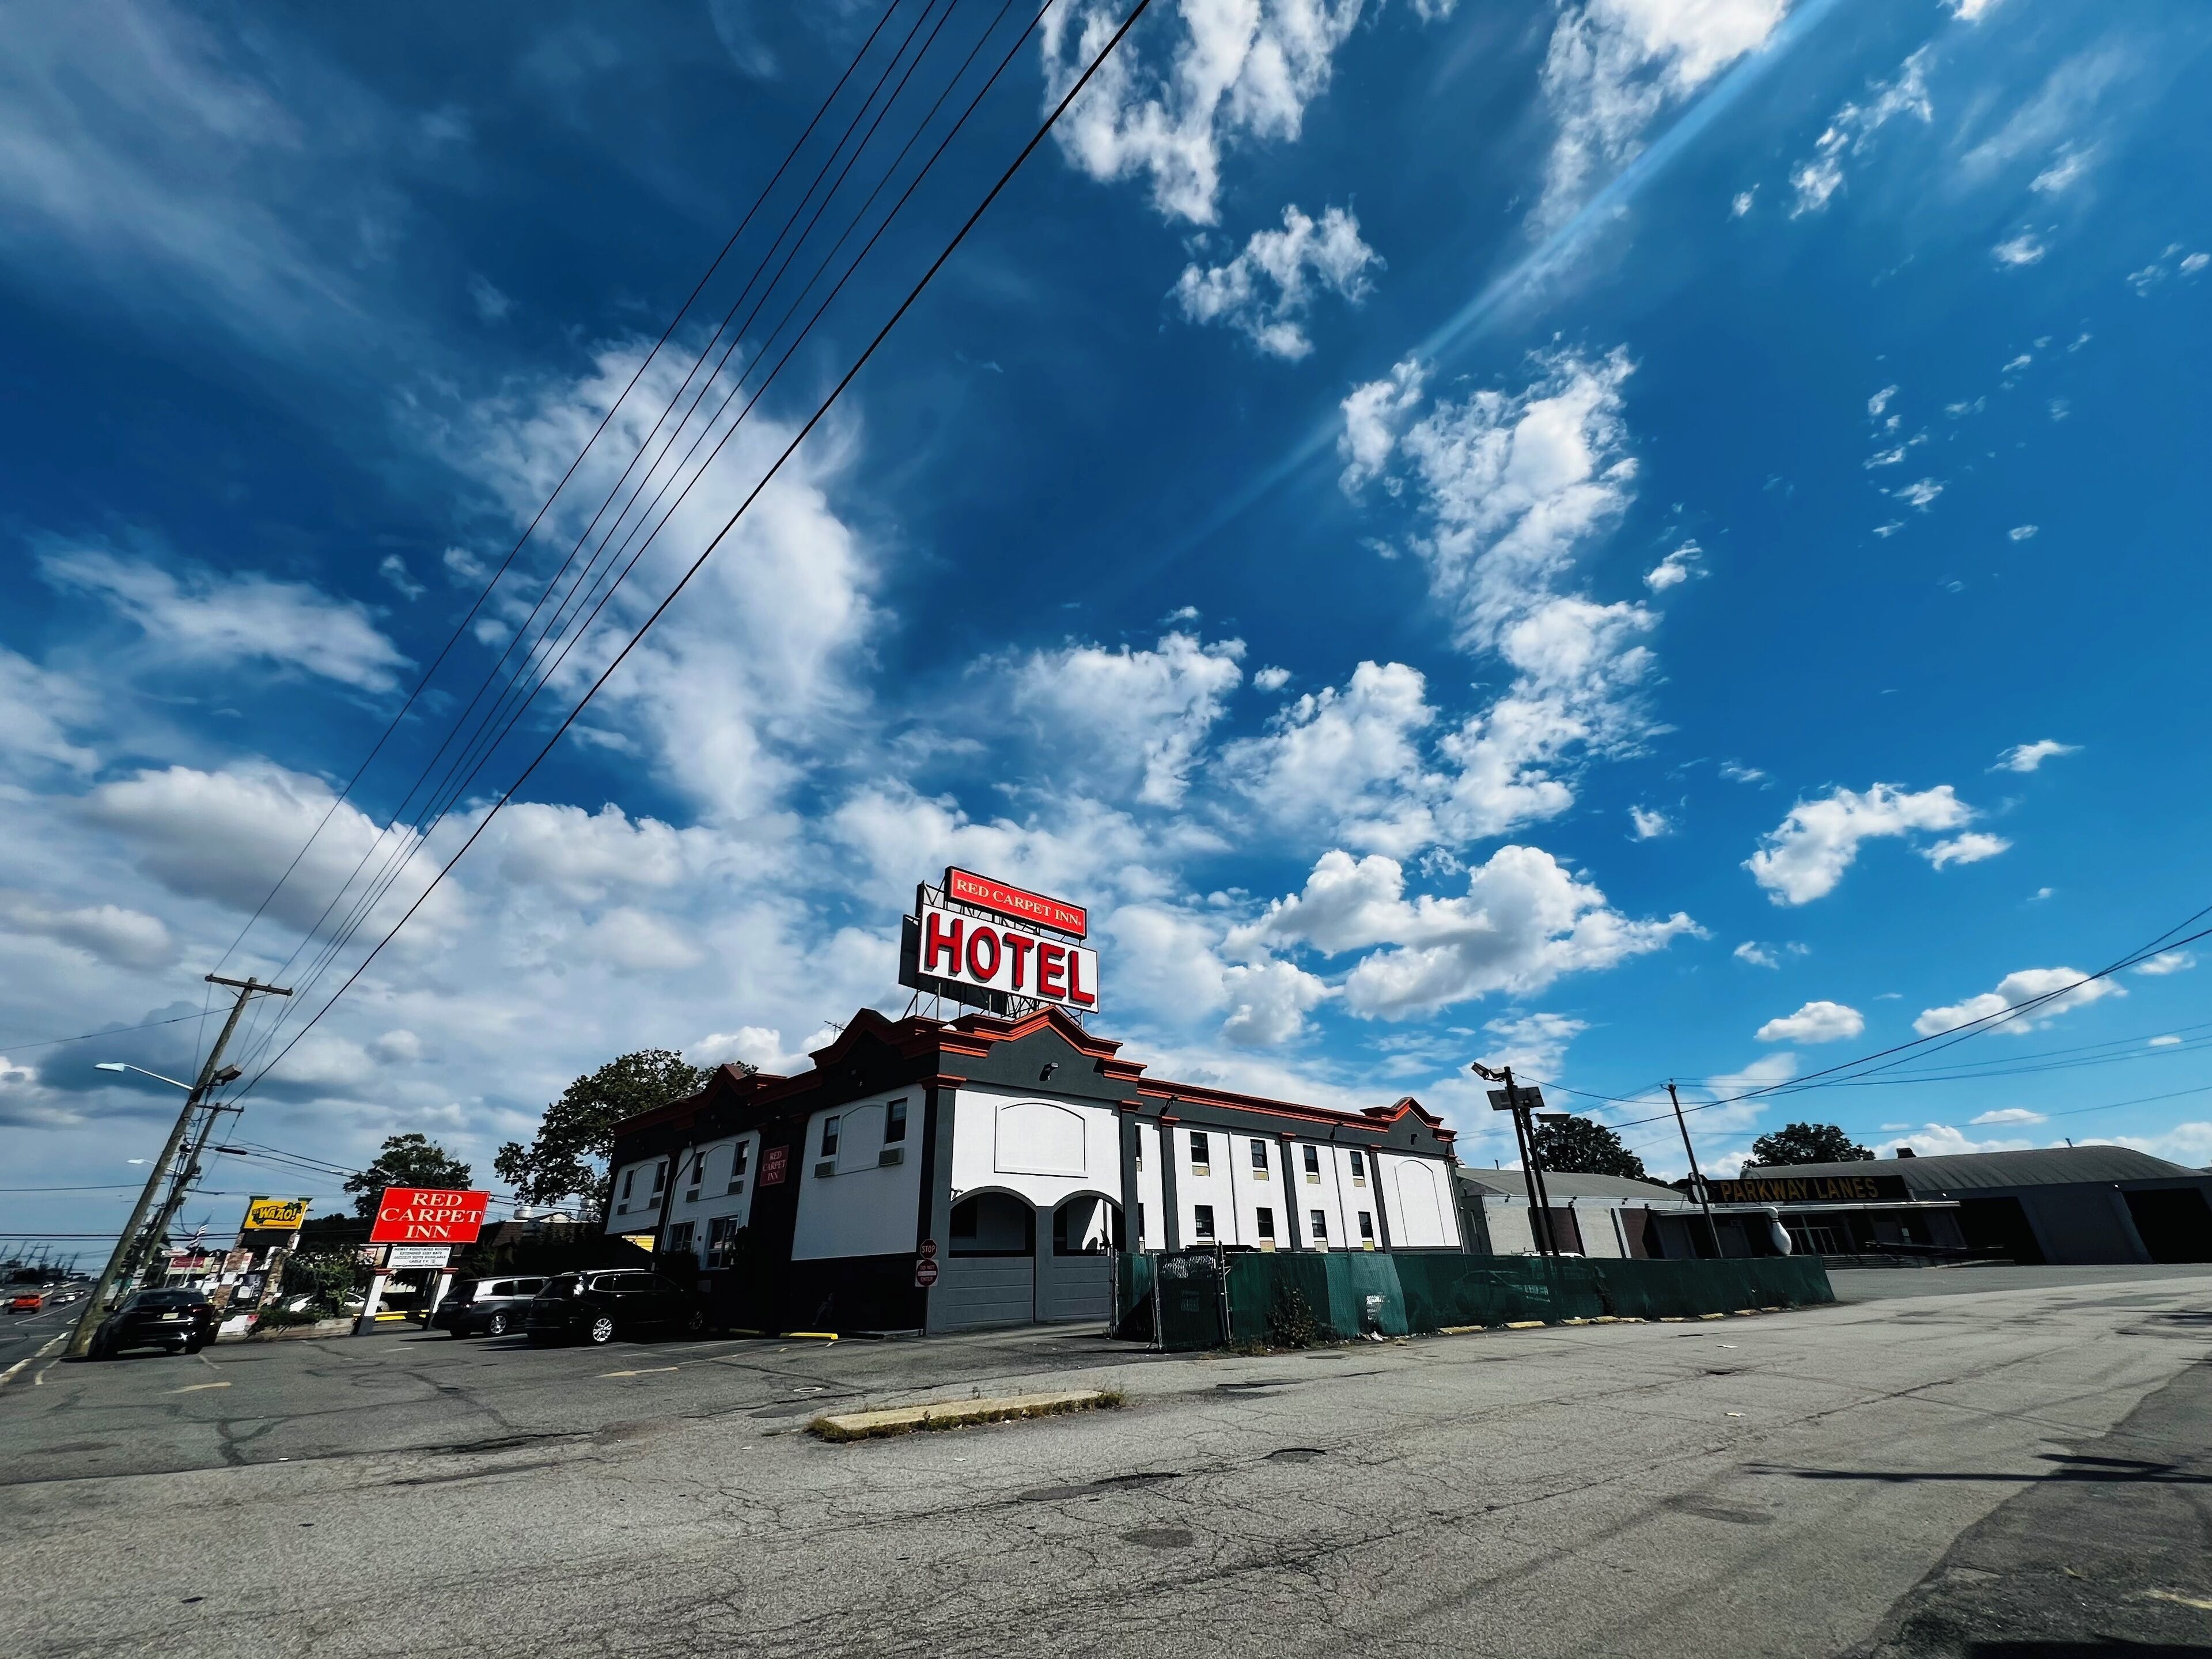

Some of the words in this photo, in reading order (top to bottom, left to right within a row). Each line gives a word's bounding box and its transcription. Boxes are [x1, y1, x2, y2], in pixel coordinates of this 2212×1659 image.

[956, 879, 989, 897] RED
[993, 891, 1052, 916] CARPET
[1055, 909, 1080, 926] INN
[925, 912, 1095, 1006] HOTEL
[770, 1150, 782, 1160] RED
[763, 1160, 787, 1171] CARPET
[1720, 1179, 1808, 1202] PARKWAY
[1813, 1177, 1878, 1199] LANES
[411, 1192, 463, 1207] RED
[381, 1207, 482, 1223] CARPET
[404, 1225, 452, 1238] INN
[922, 1245, 935, 1253] STOP
